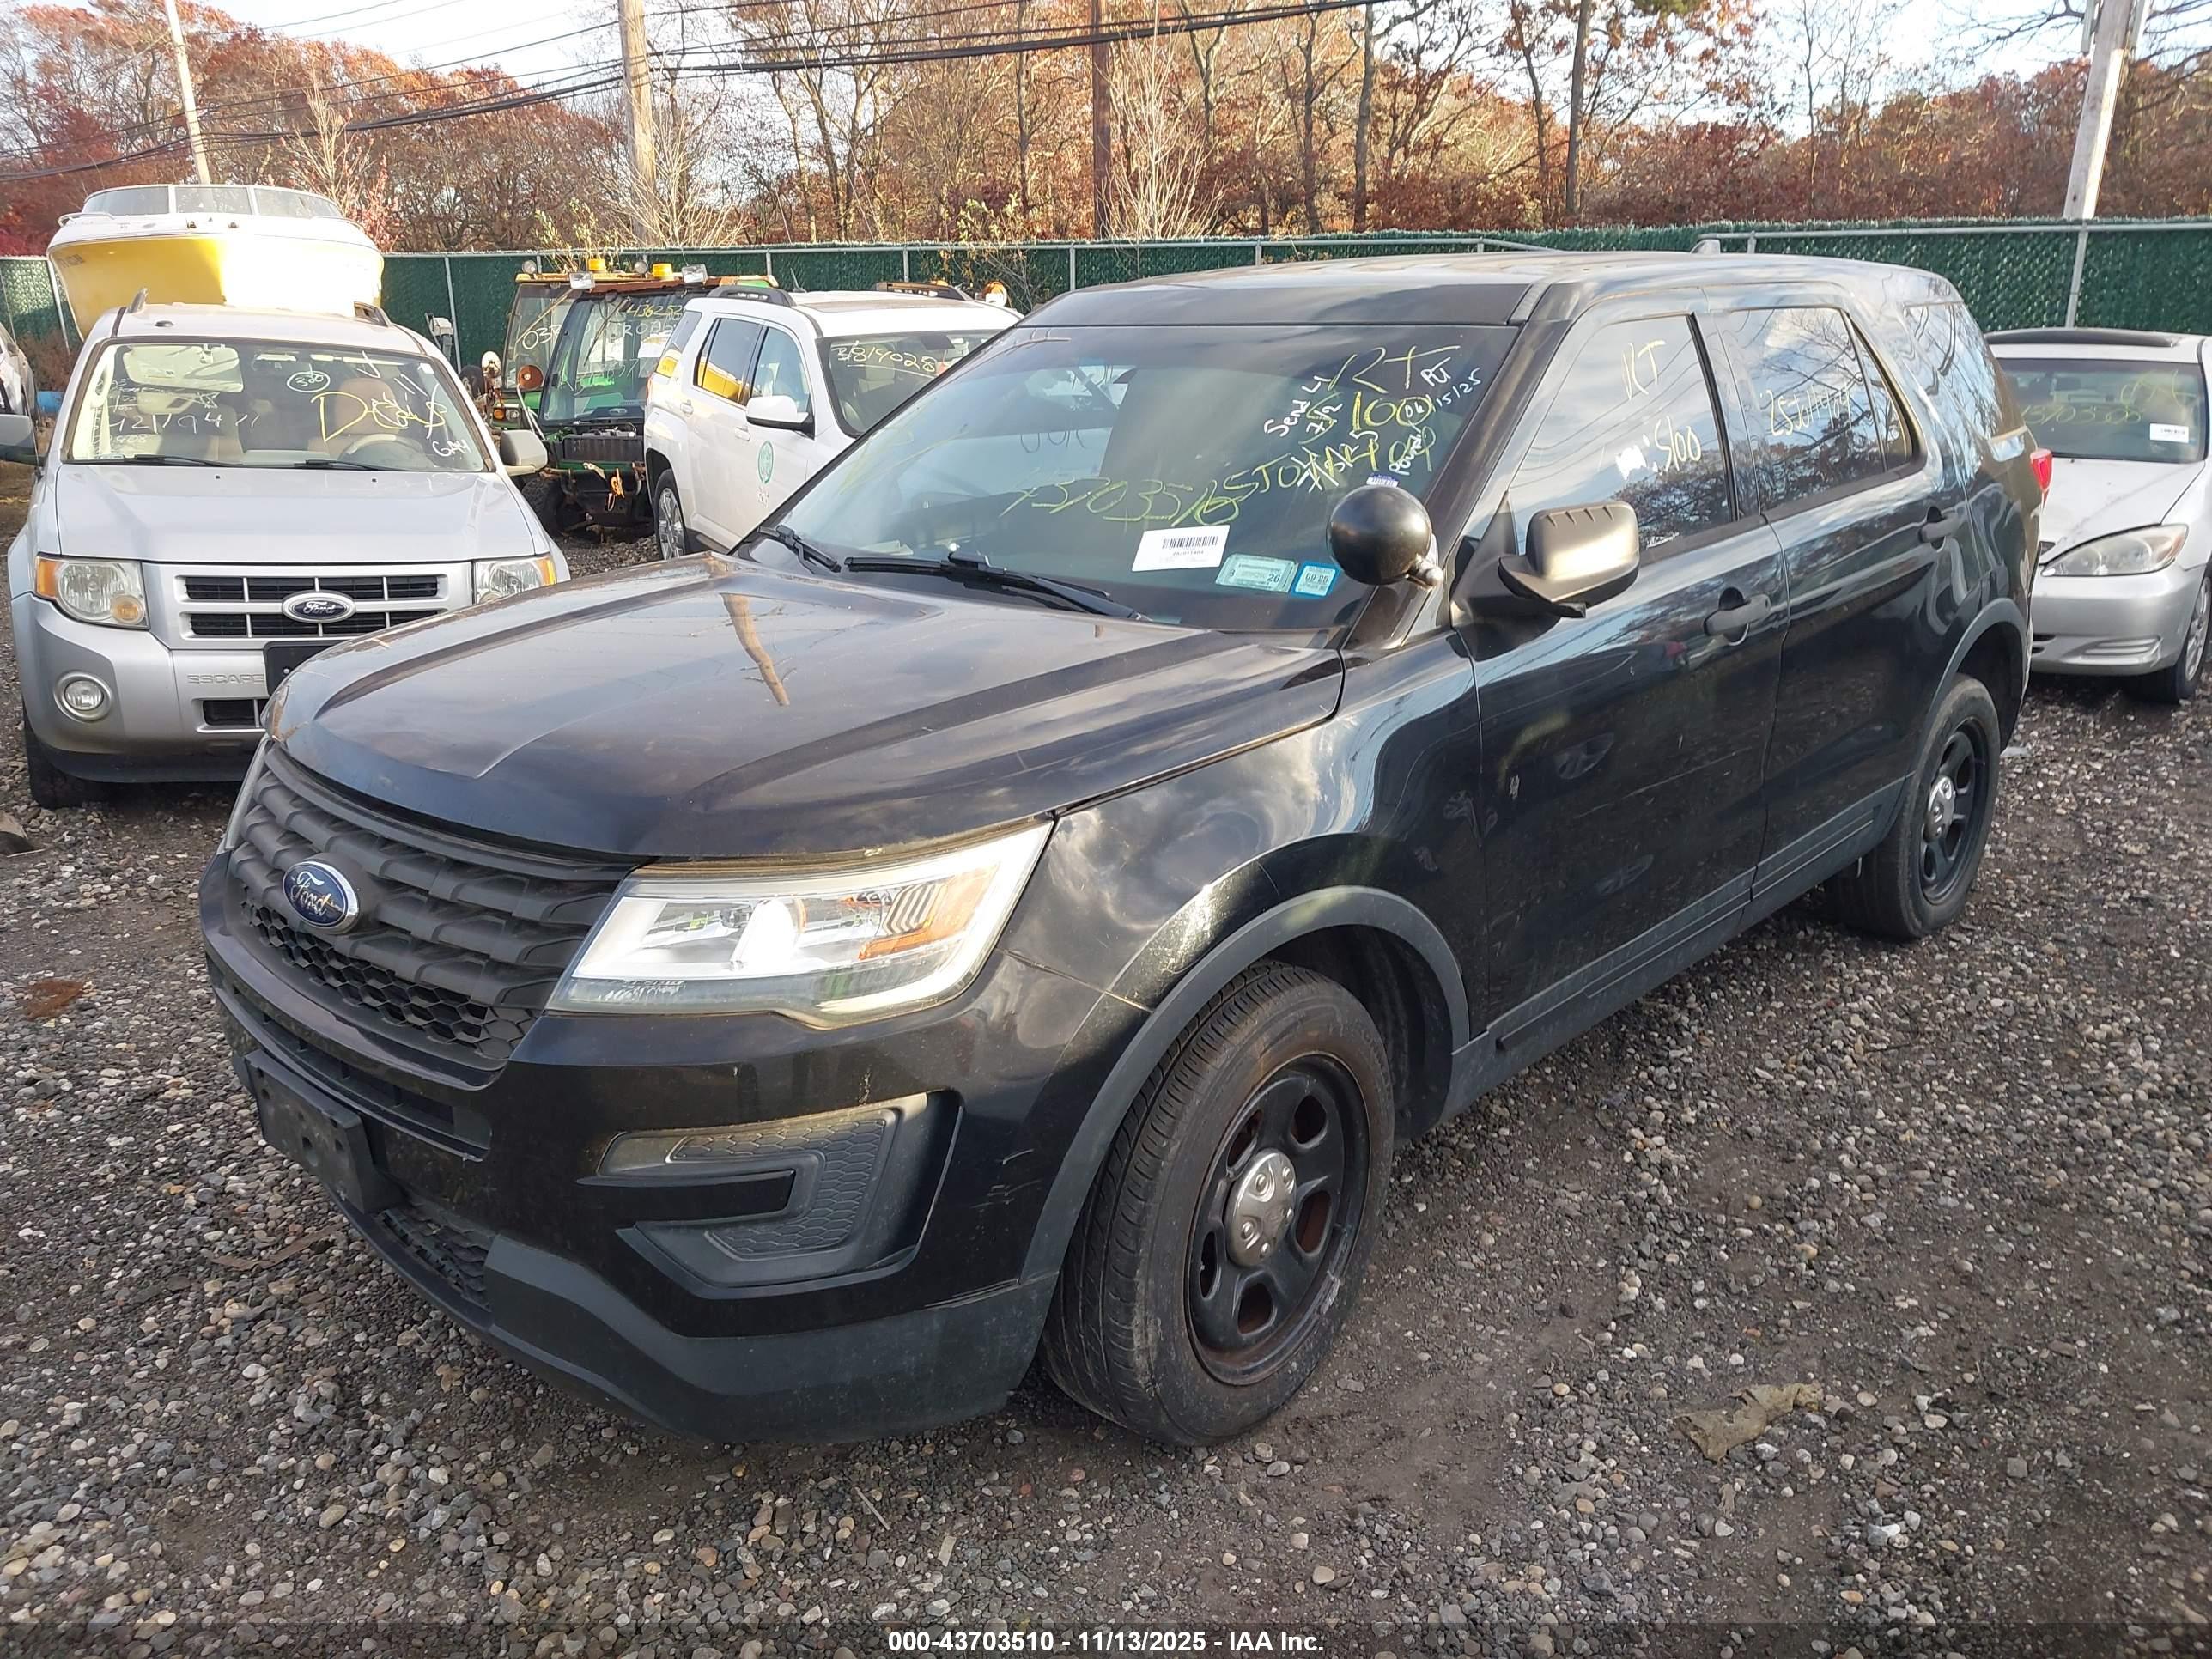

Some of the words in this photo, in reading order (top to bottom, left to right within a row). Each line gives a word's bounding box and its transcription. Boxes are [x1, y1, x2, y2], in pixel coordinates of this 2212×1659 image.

[302, 600, 336, 615] Ford
[187, 674, 265, 684] ESCAPE
[290, 871, 331, 916] Ford
